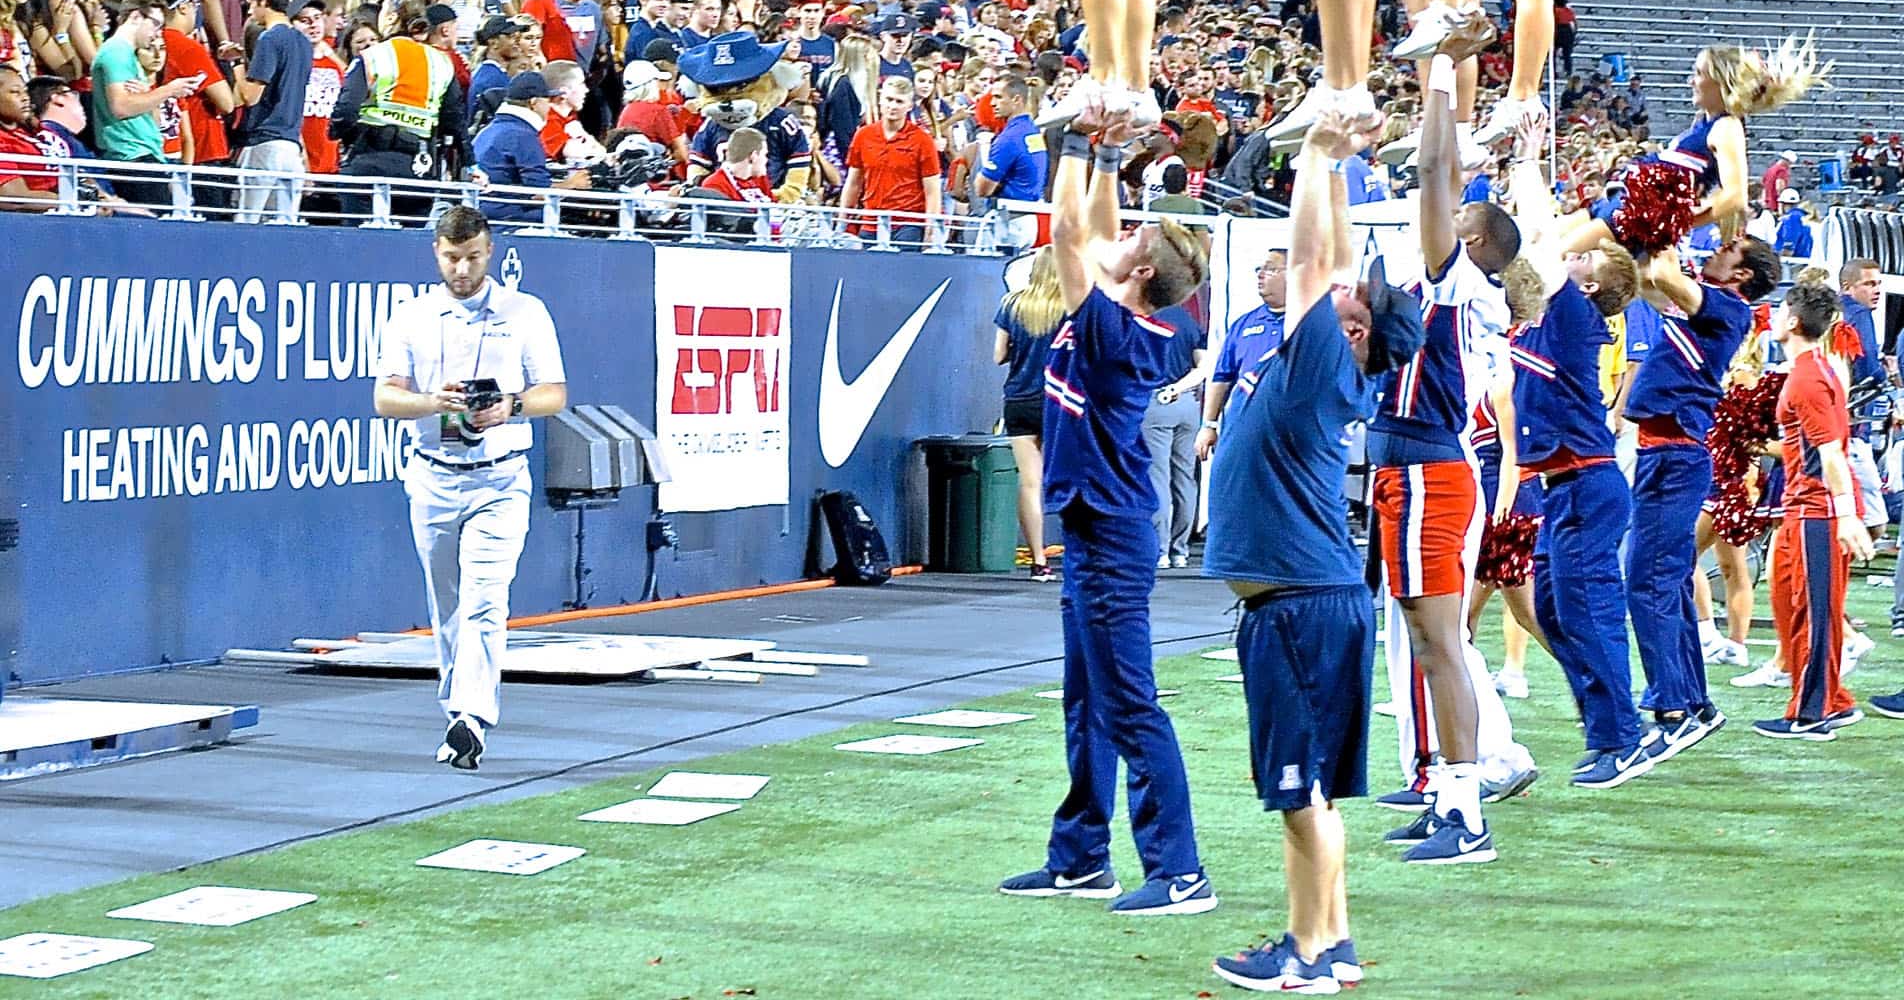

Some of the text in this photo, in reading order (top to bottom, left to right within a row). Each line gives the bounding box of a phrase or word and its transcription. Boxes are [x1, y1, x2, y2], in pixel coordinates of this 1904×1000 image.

[383, 110, 427, 128] POLICE
[19, 275, 266, 388] CUMMINGS
[63, 418, 416, 502] HEATING AND COOLING
